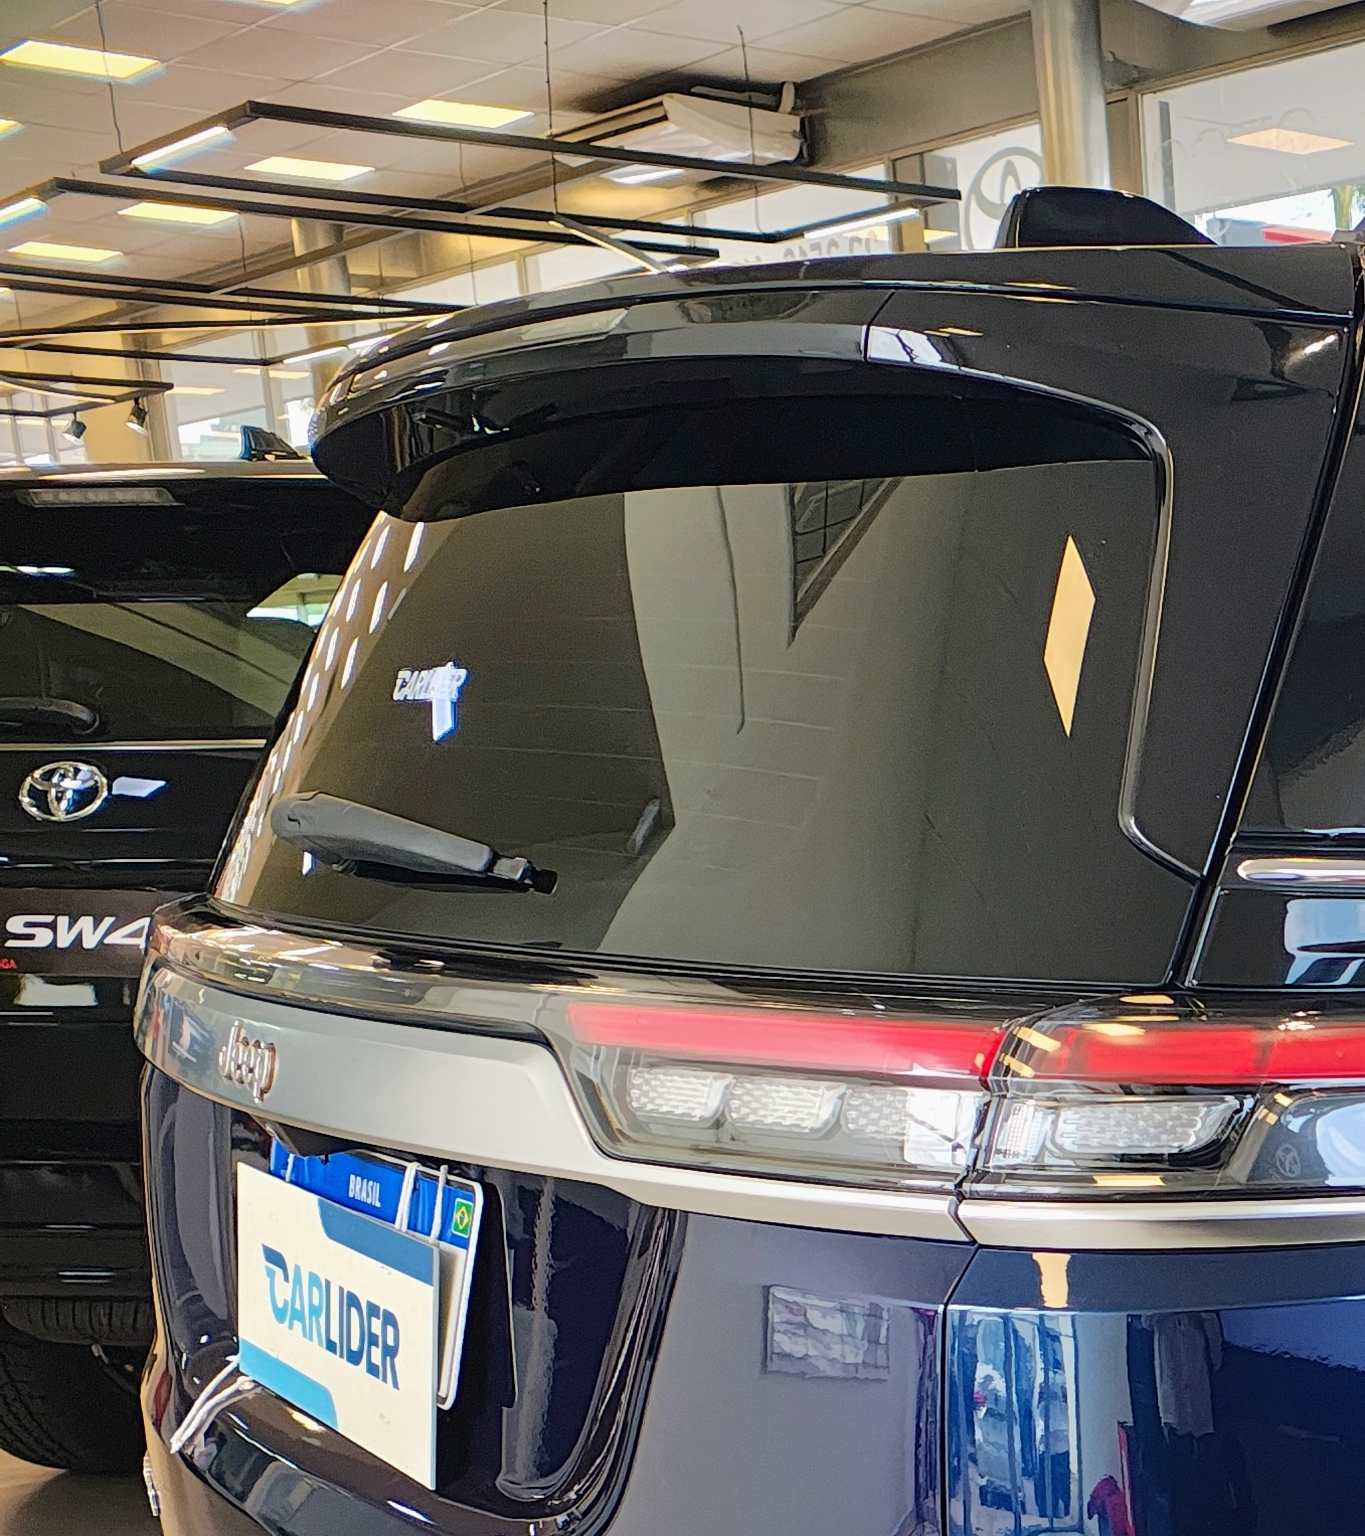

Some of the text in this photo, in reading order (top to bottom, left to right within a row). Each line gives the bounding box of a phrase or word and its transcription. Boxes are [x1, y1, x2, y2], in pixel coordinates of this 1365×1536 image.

[4, 914, 151, 955] SW4
[347, 1173, 382, 1208] BRASIL
[261, 1243, 401, 1391] CARLIDER
